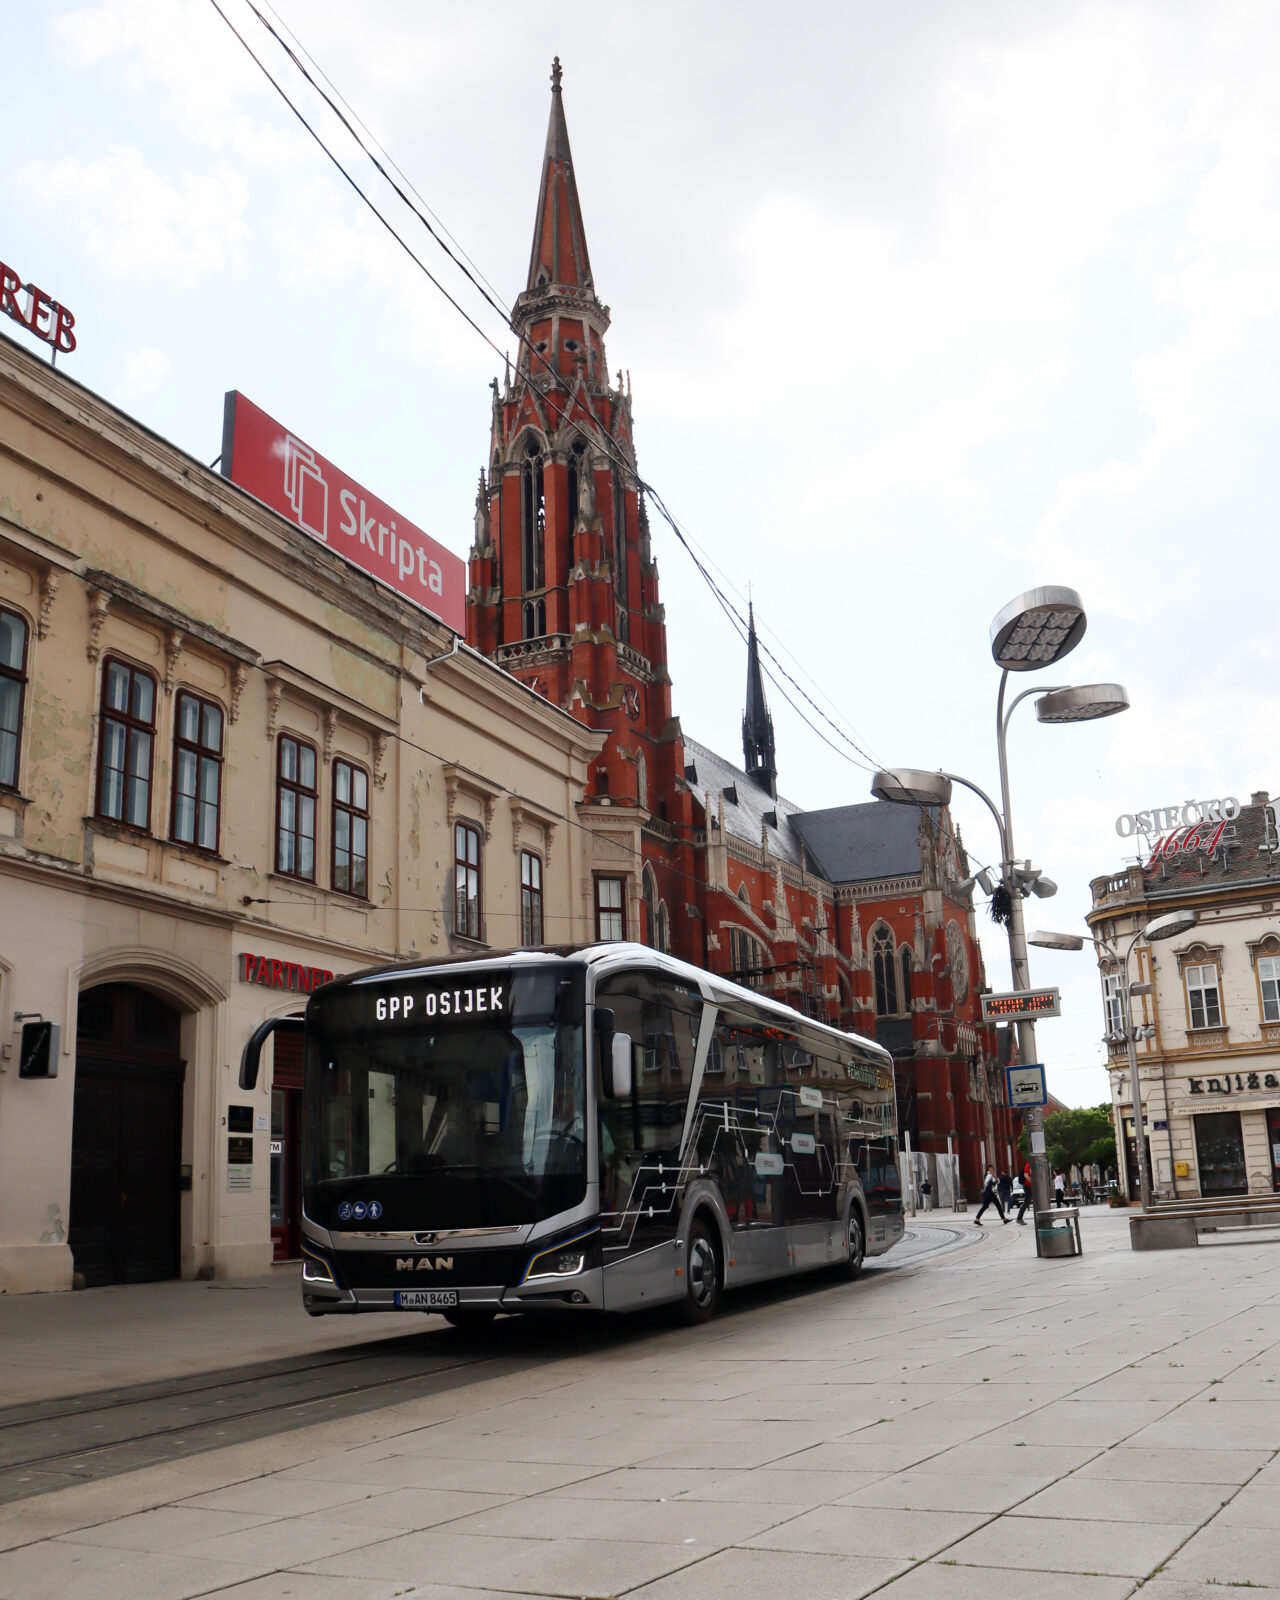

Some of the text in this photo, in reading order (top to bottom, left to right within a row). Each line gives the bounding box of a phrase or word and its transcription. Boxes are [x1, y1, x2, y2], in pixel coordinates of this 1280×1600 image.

[339, 488, 443, 596] Skripta
[1115, 797, 1241, 840] OSJEČKO
[1143, 820, 1229, 871] 1664
[376, 986, 503, 1021] GPP OSIJEK
[1188, 1072, 1280, 1095] knjiža
[396, 1257, 454, 1270] MAN
[430, 1293, 456, 1304] 8465
